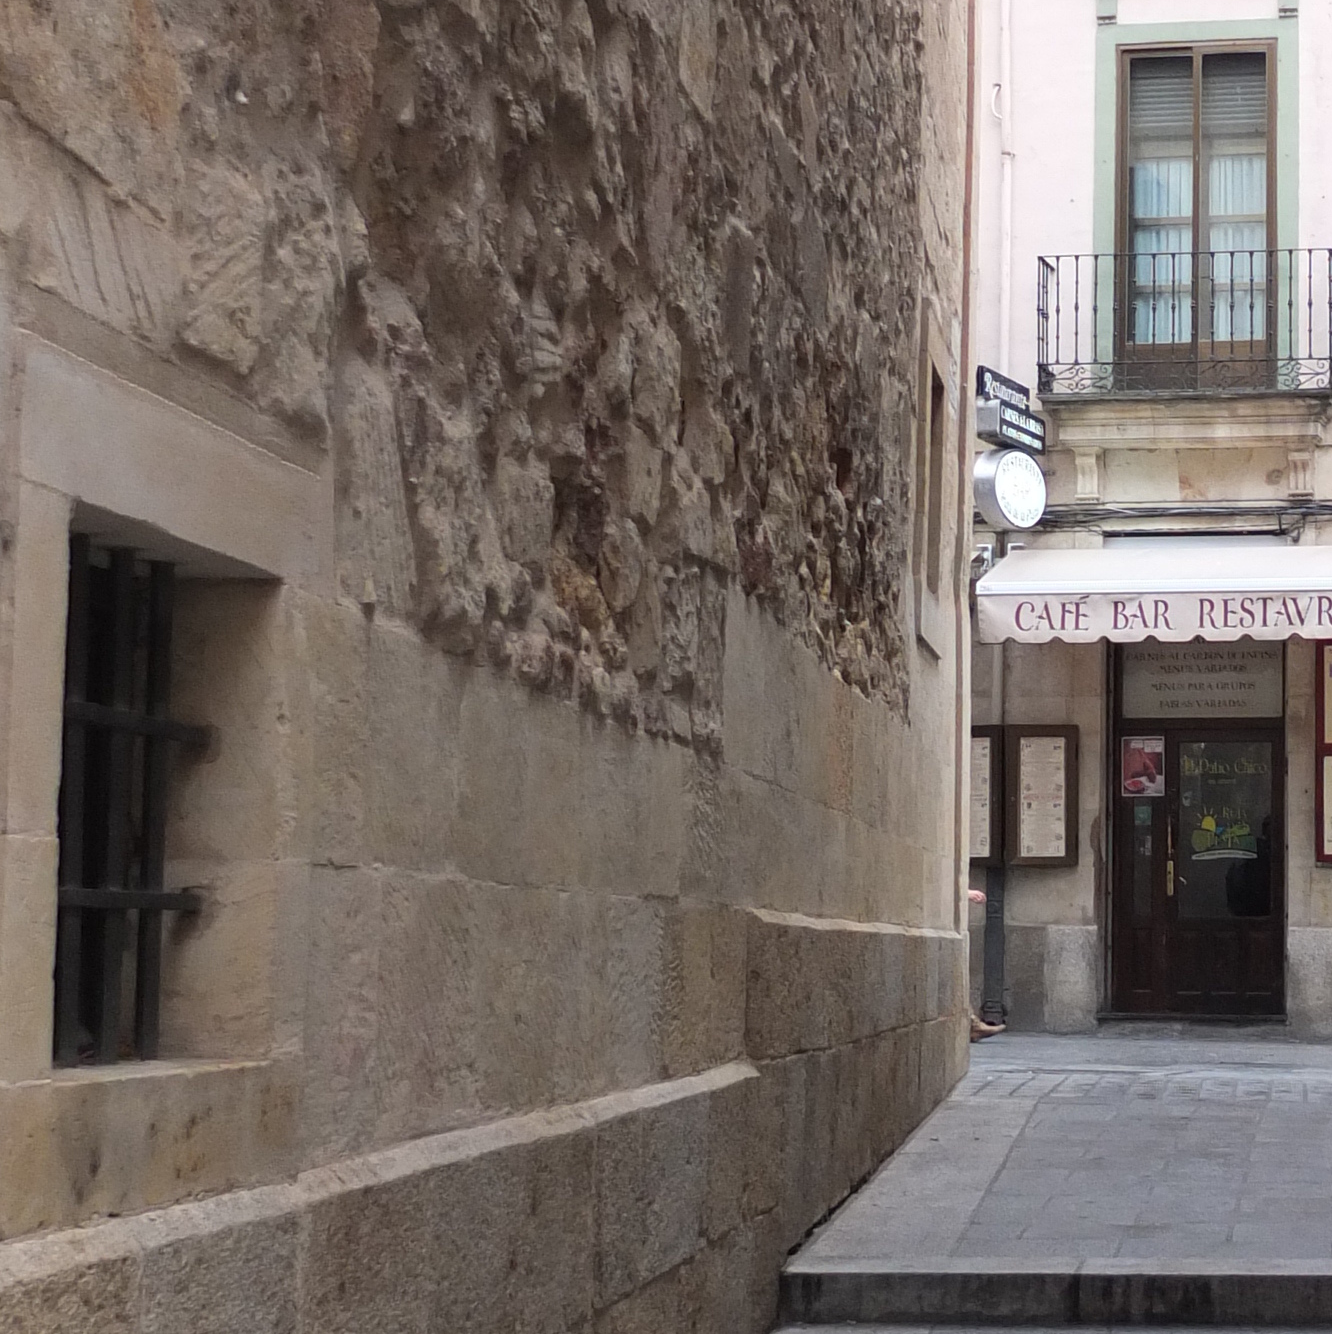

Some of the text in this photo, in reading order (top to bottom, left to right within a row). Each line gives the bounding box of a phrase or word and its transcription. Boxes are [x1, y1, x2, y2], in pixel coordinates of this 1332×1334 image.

[1014, 594, 1090, 632] CAFÉ
[1111, 598, 1177, 631] BAR
[1187, 682, 1213, 692] PARA
